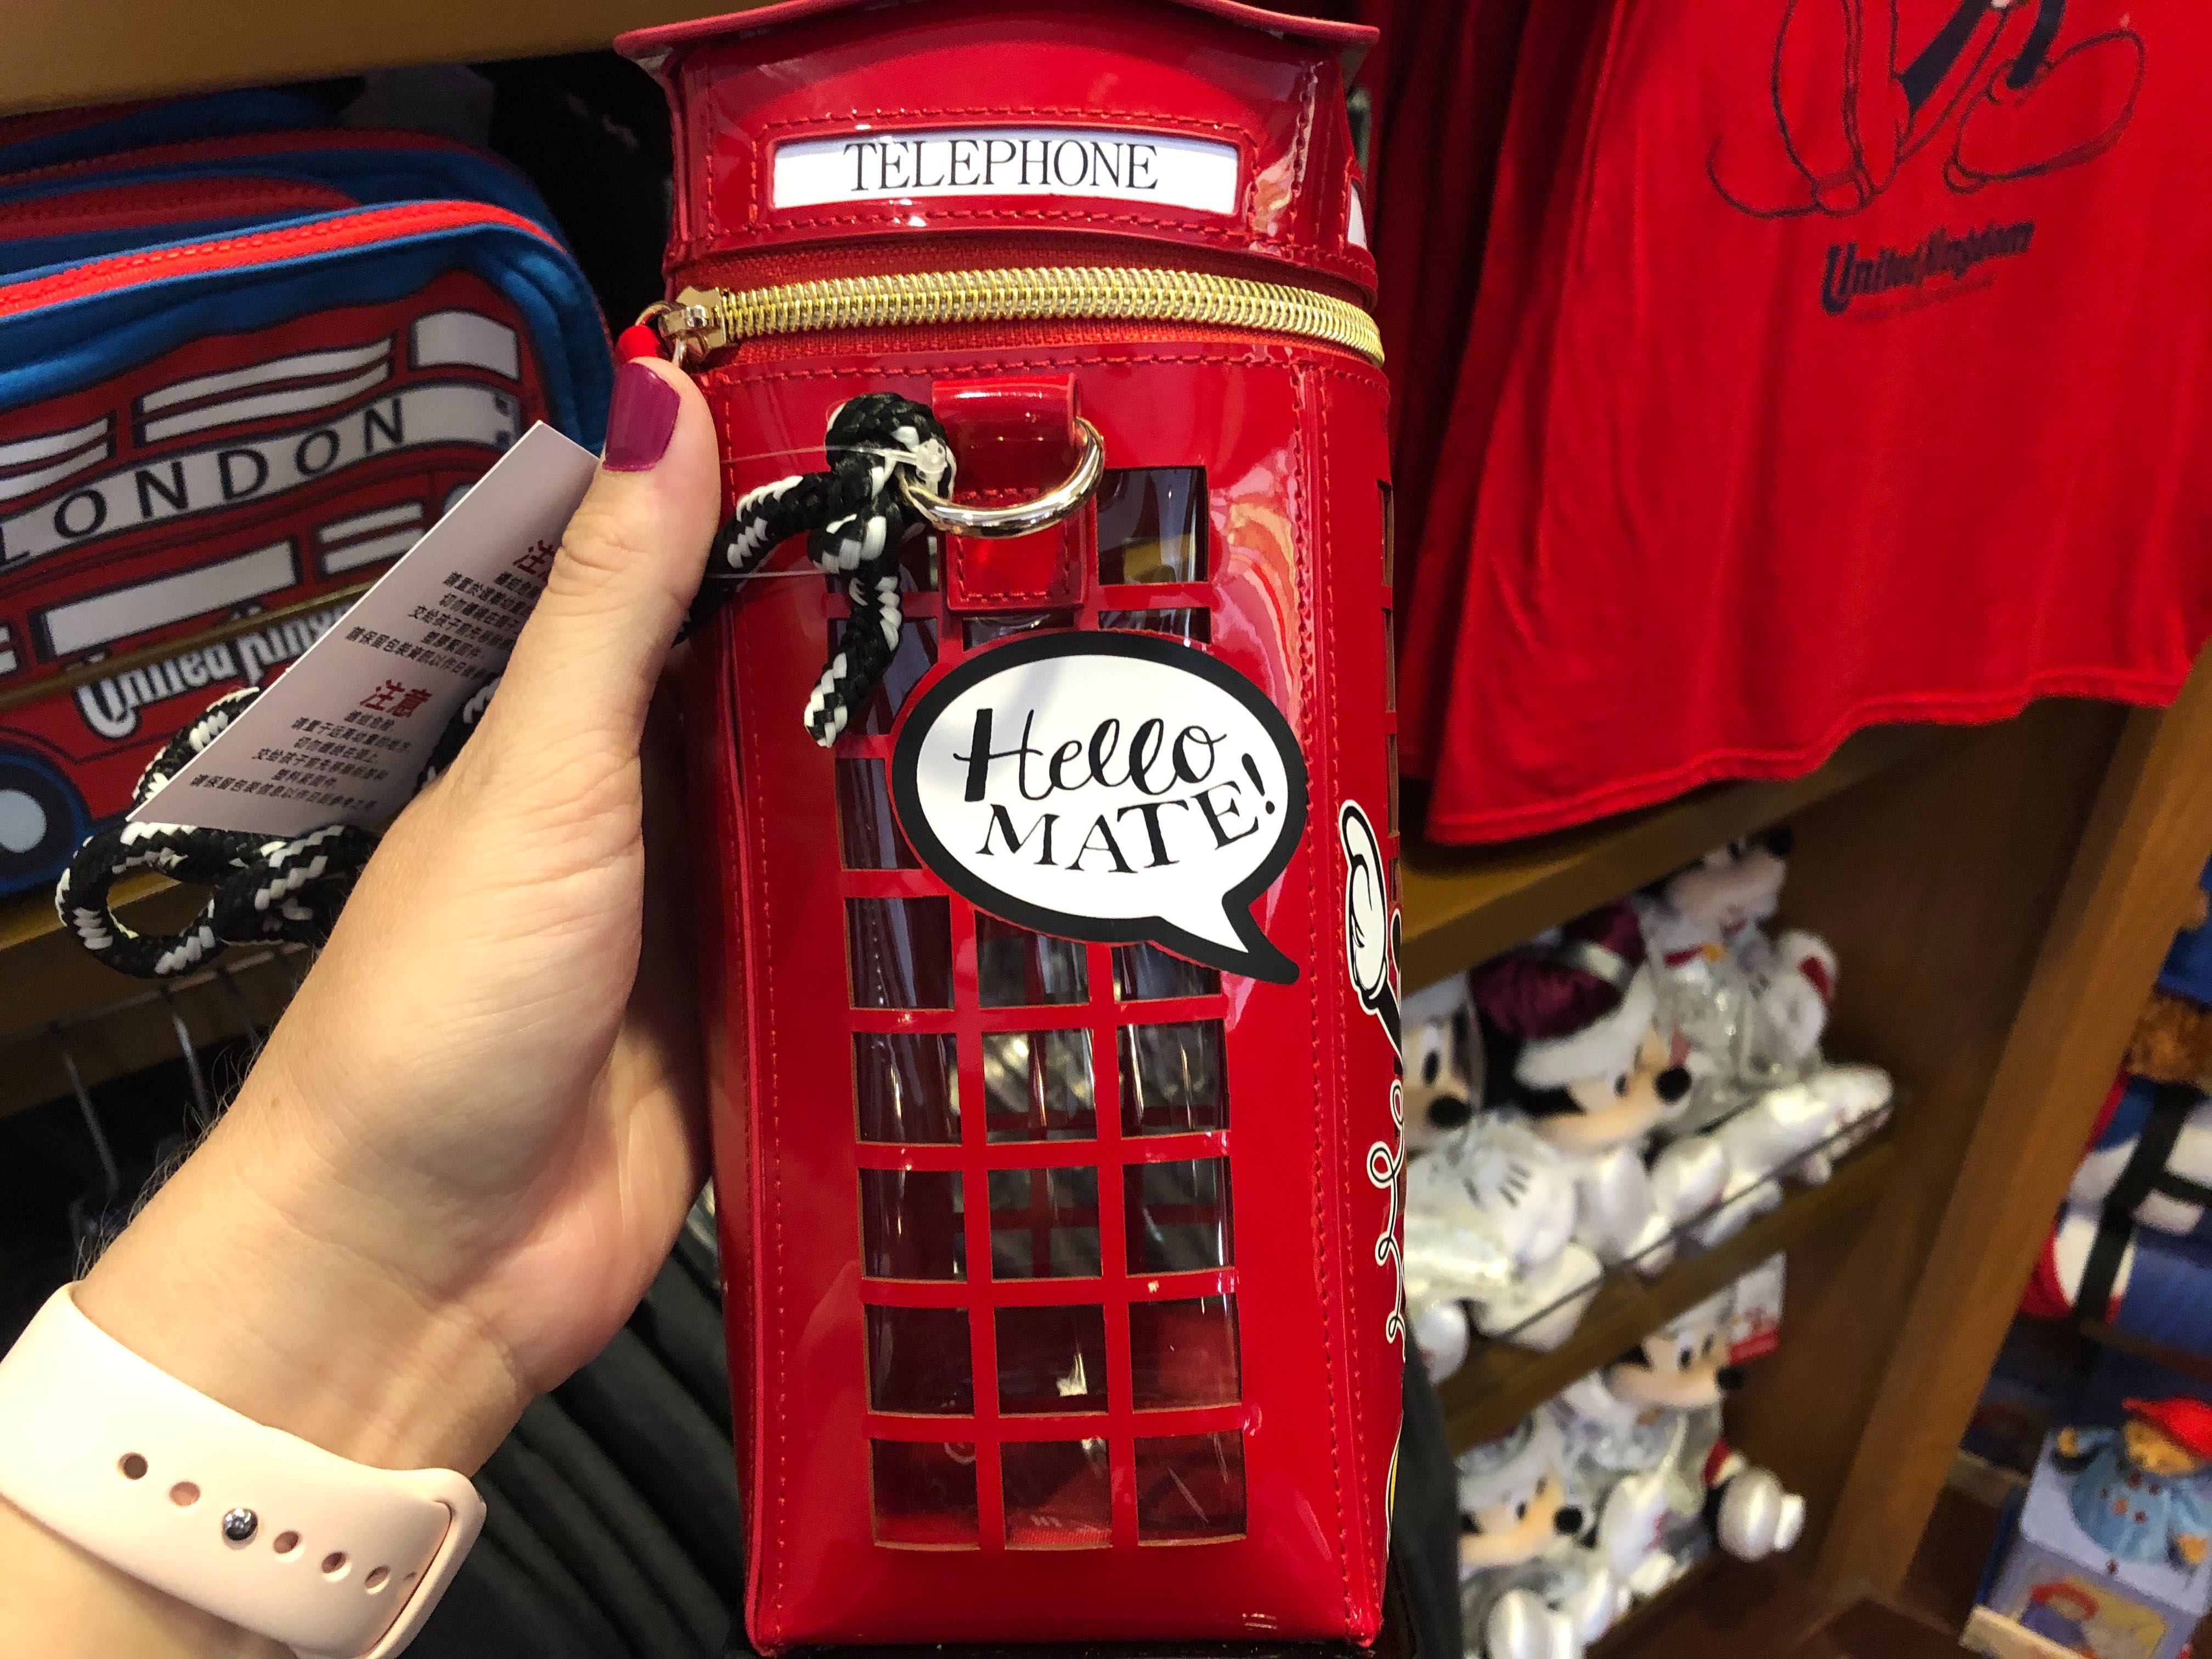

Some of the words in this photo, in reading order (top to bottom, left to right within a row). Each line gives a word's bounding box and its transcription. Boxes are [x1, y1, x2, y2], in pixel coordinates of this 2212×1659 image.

[843, 138, 1158, 193] TELEPHONE
[0, 398, 404, 565] LONDON
[359, 679, 433, 718] 注意
[953, 708, 1227, 802] Hello
[975, 752, 1276, 873] MATE!
